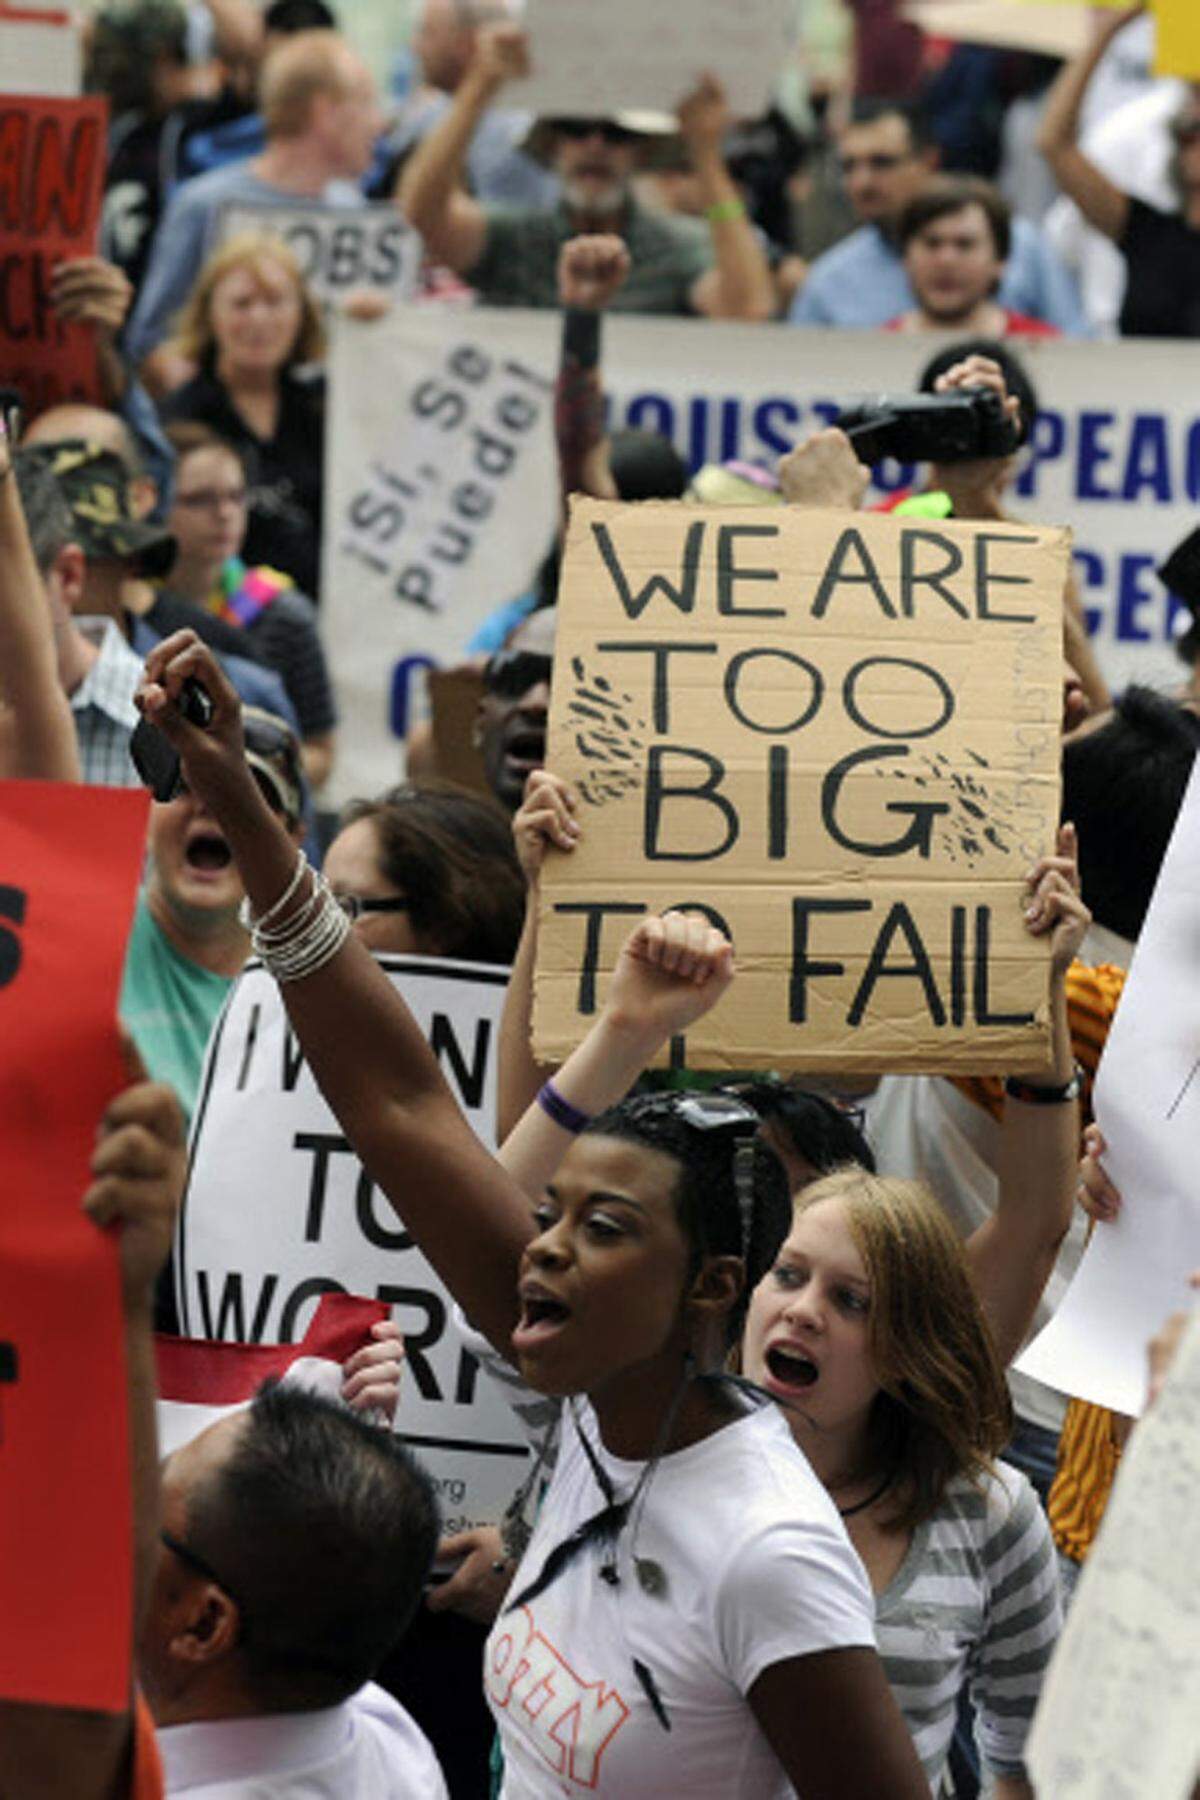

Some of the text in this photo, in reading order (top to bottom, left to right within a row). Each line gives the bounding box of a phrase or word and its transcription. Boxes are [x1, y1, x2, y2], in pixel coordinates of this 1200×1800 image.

[590, 521, 1037, 624] WE ARE
[596, 642, 956, 740] TOO
[643, 743, 951, 861] BIG
[789, 897, 1036, 1028] FAIL
